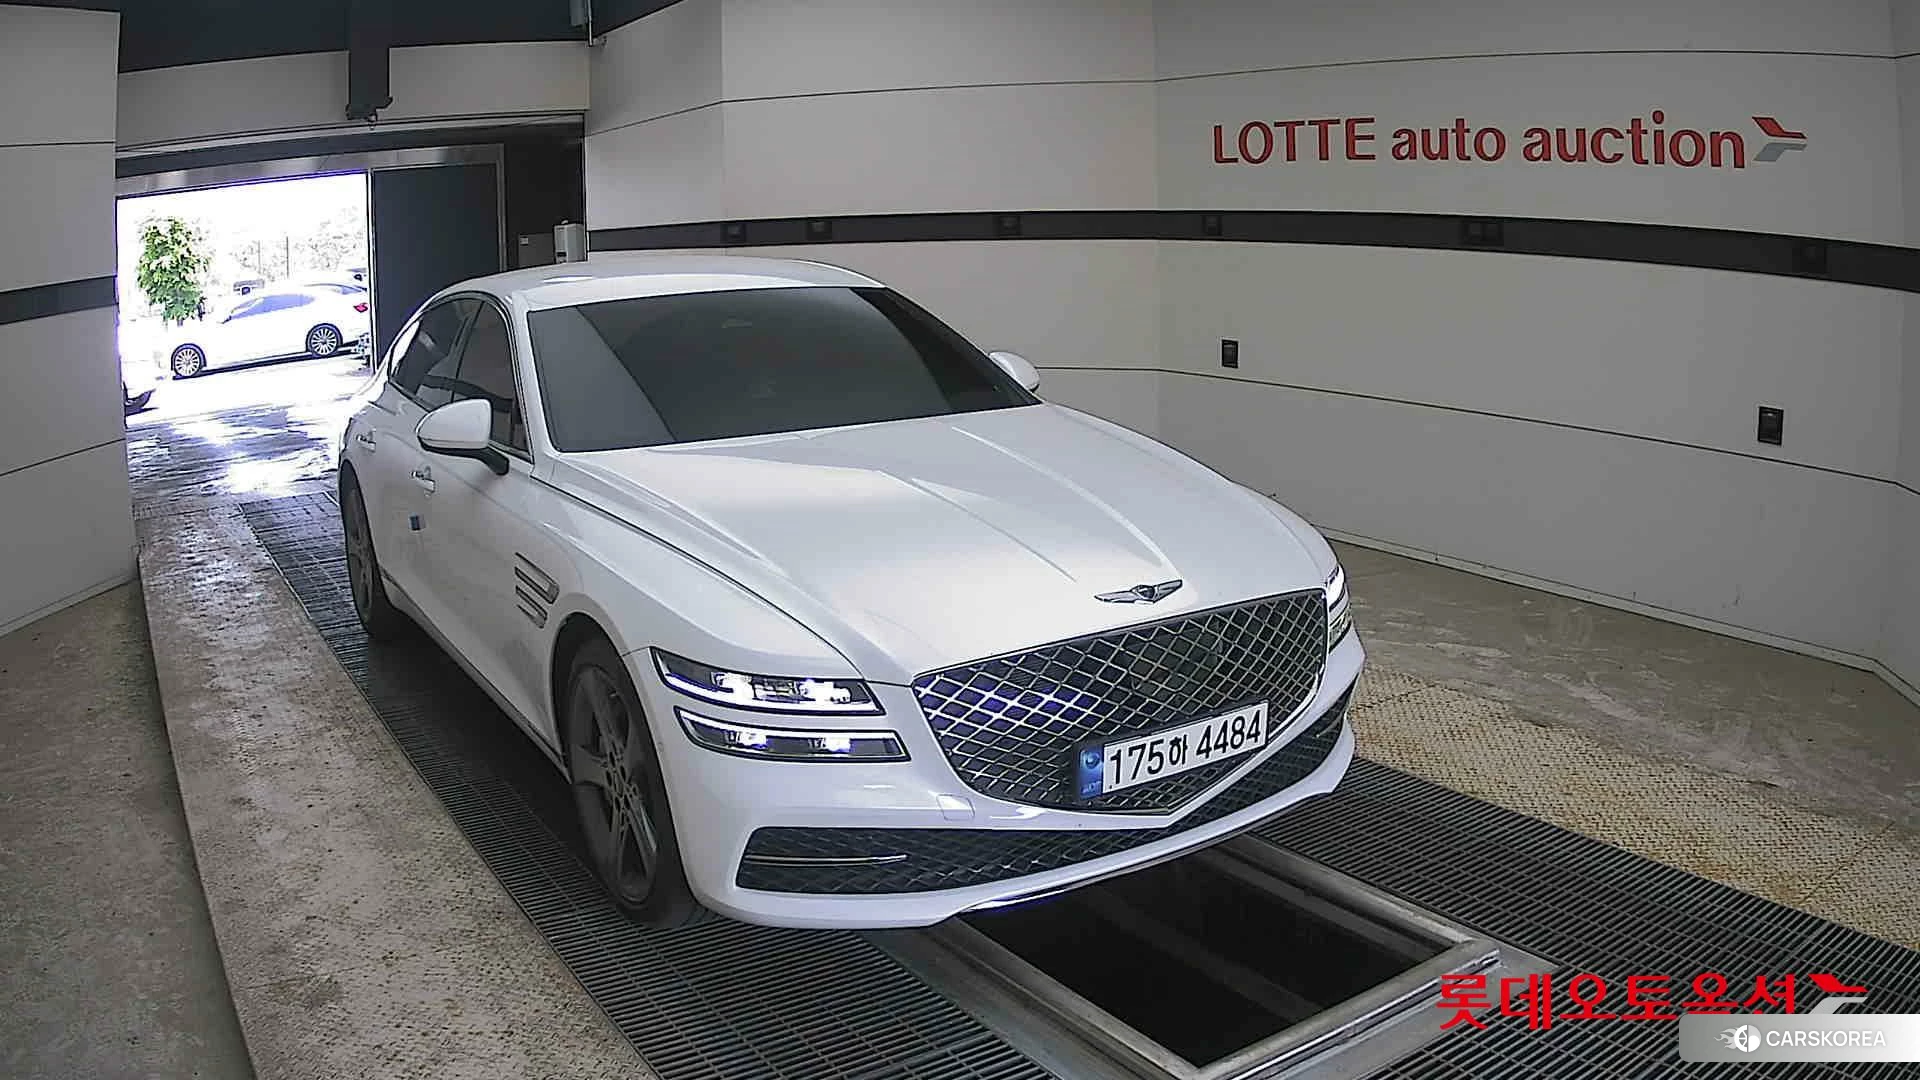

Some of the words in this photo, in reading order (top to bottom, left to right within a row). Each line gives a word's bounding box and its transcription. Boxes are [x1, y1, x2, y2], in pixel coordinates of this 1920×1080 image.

[1212, 117, 1376, 164] LOTTE
[1391, 118, 1506, 161] auto
[1522, 110, 1746, 169] auction
[1109, 733, 1188, 785] 175하
[1195, 709, 1261, 760] 4484
